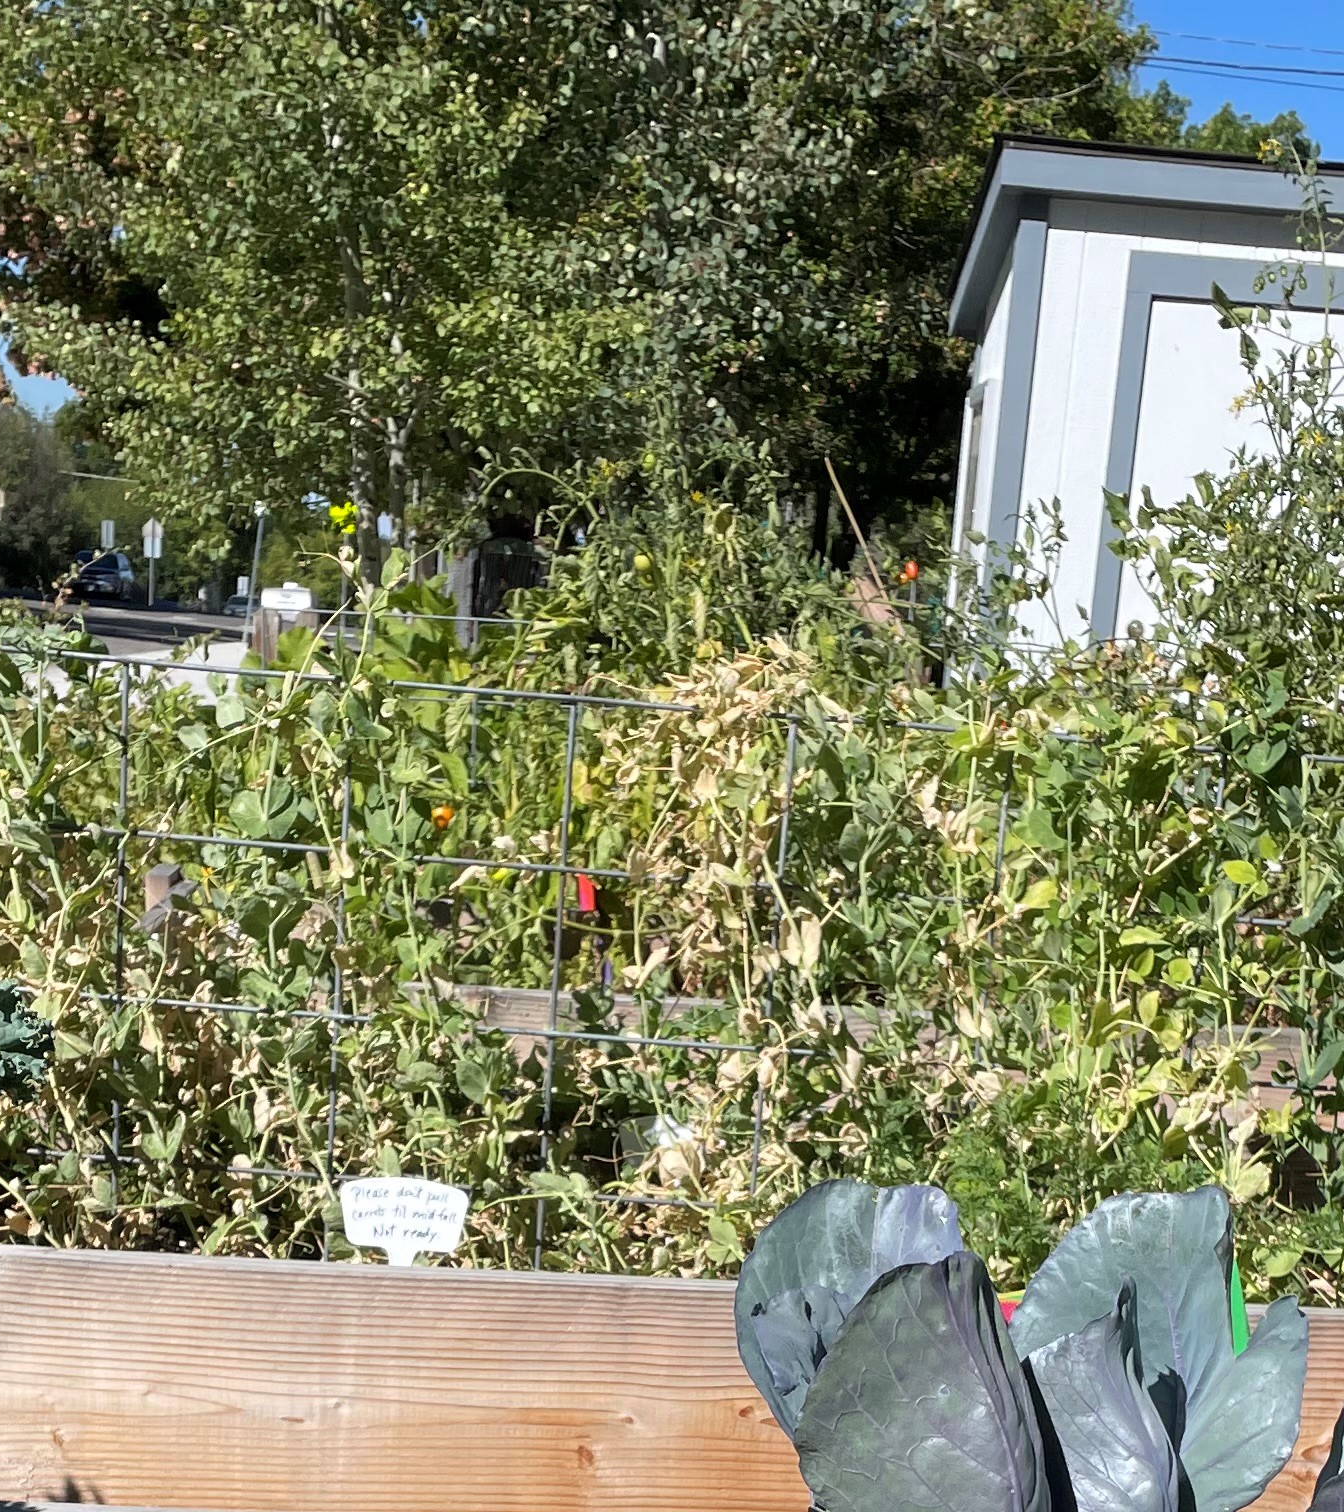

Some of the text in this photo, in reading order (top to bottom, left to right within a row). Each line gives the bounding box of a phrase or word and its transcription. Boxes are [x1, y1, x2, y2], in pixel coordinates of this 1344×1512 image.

[350, 1186, 449, 1205] Please don't pull
[373, 1223, 396, 1238] Not
